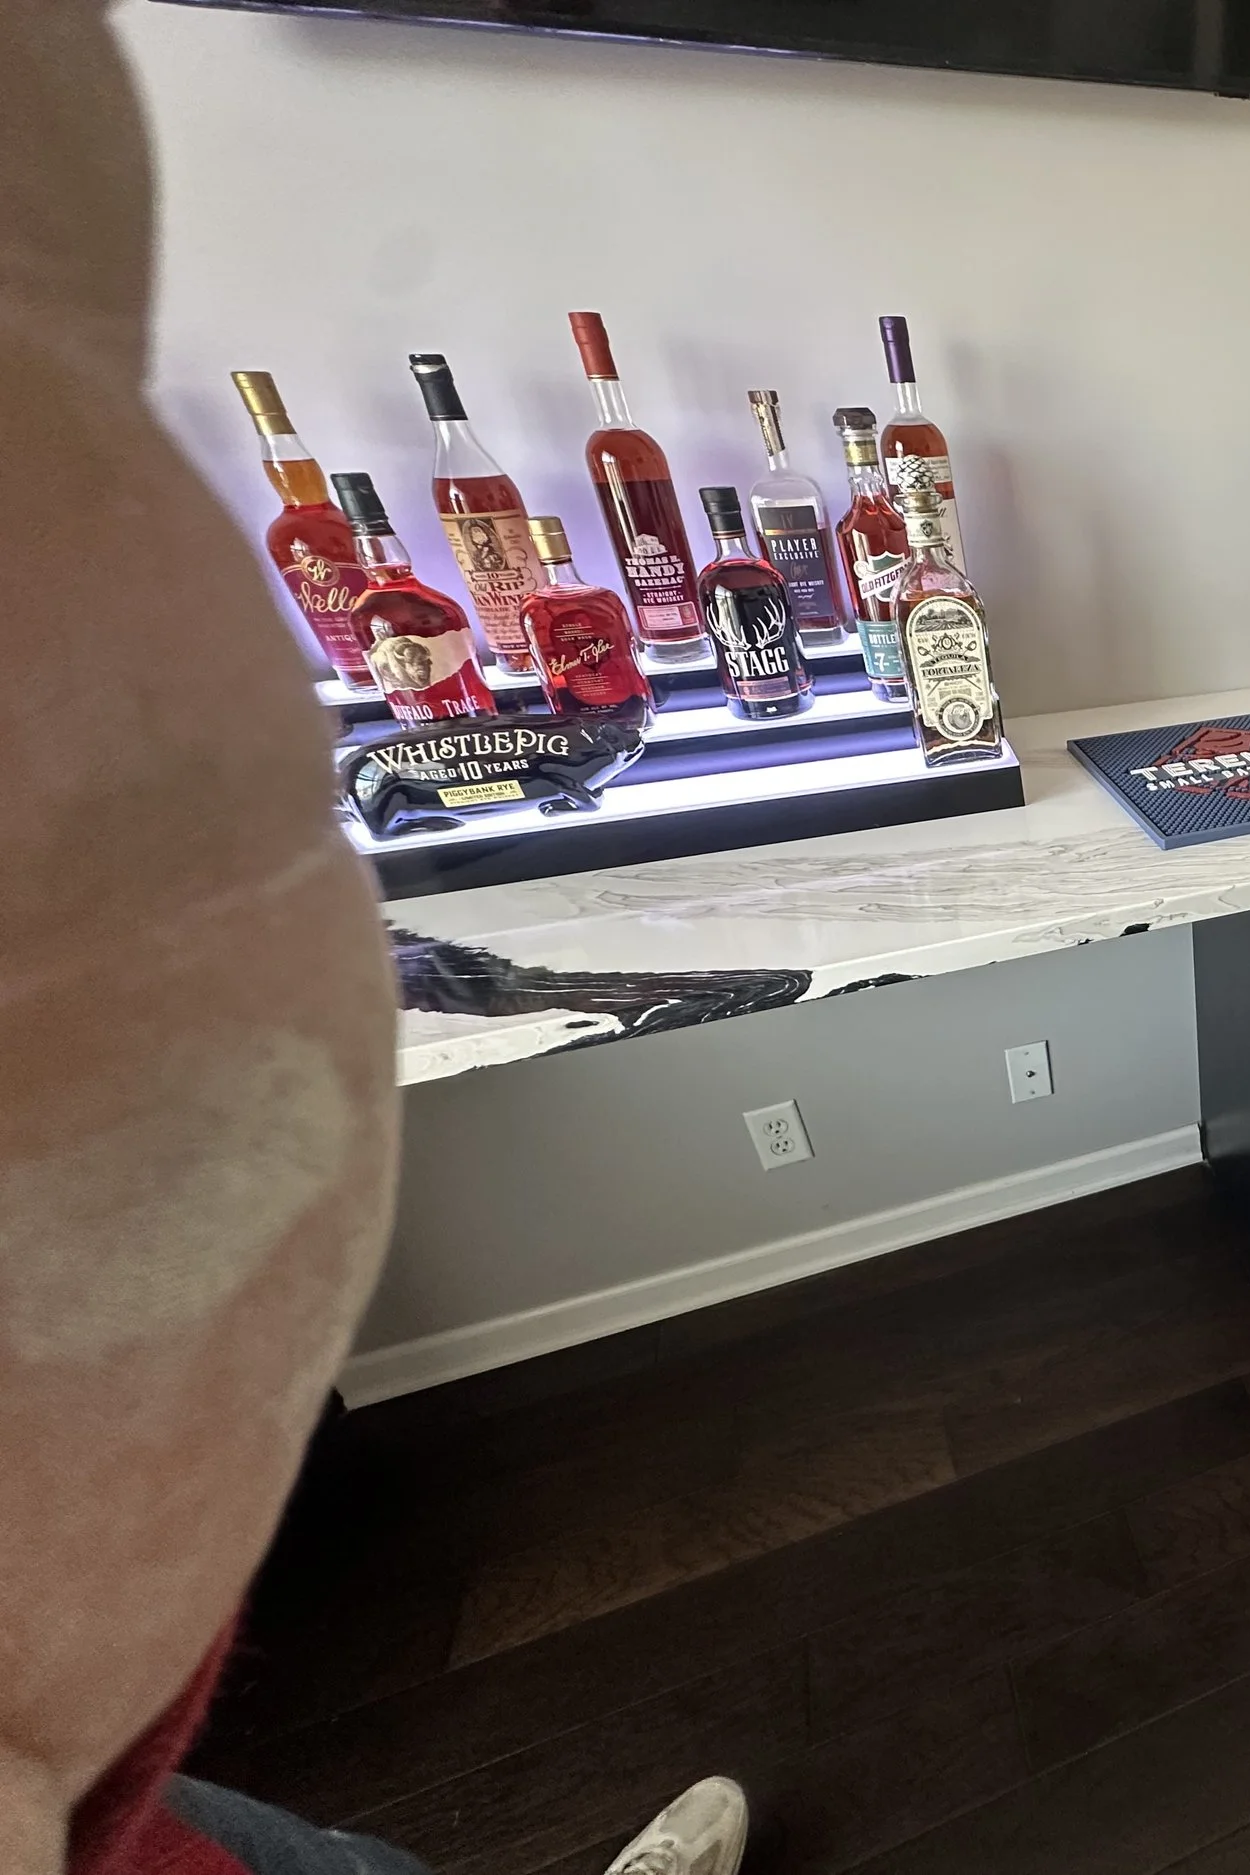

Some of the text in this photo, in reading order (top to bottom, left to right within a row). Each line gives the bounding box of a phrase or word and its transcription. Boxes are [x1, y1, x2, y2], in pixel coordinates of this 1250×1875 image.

[771, 537, 817, 552] PLAYER
[624, 556, 669, 566] THOMAS
[773, 551, 820, 561] EXCLUSIVE
[625, 563, 685, 578] HANDY
[475, 581, 525, 591] Old RIP
[634, 576, 685, 587] SAZERAC
[861, 582, 875, 593] OLD
[295, 581, 358, 613] Welle
[486, 590, 524, 606] WINK
[325, 634, 355, 642] ANTIQ
[868, 633, 898, 645] BOTTLE
[724, 646, 790, 678] STAGG
[874, 652, 886, 673] 7
[920, 664, 980, 678] FORTALEZA
[441, 695, 481, 717] TRACE
[366, 728, 570, 775] WHISTLEPIG
[419, 758, 530, 781] AGED 10 YEARS
[443, 782, 515, 798] PIGGYBANK RYE
[1146, 774, 1214, 791] SMALL
